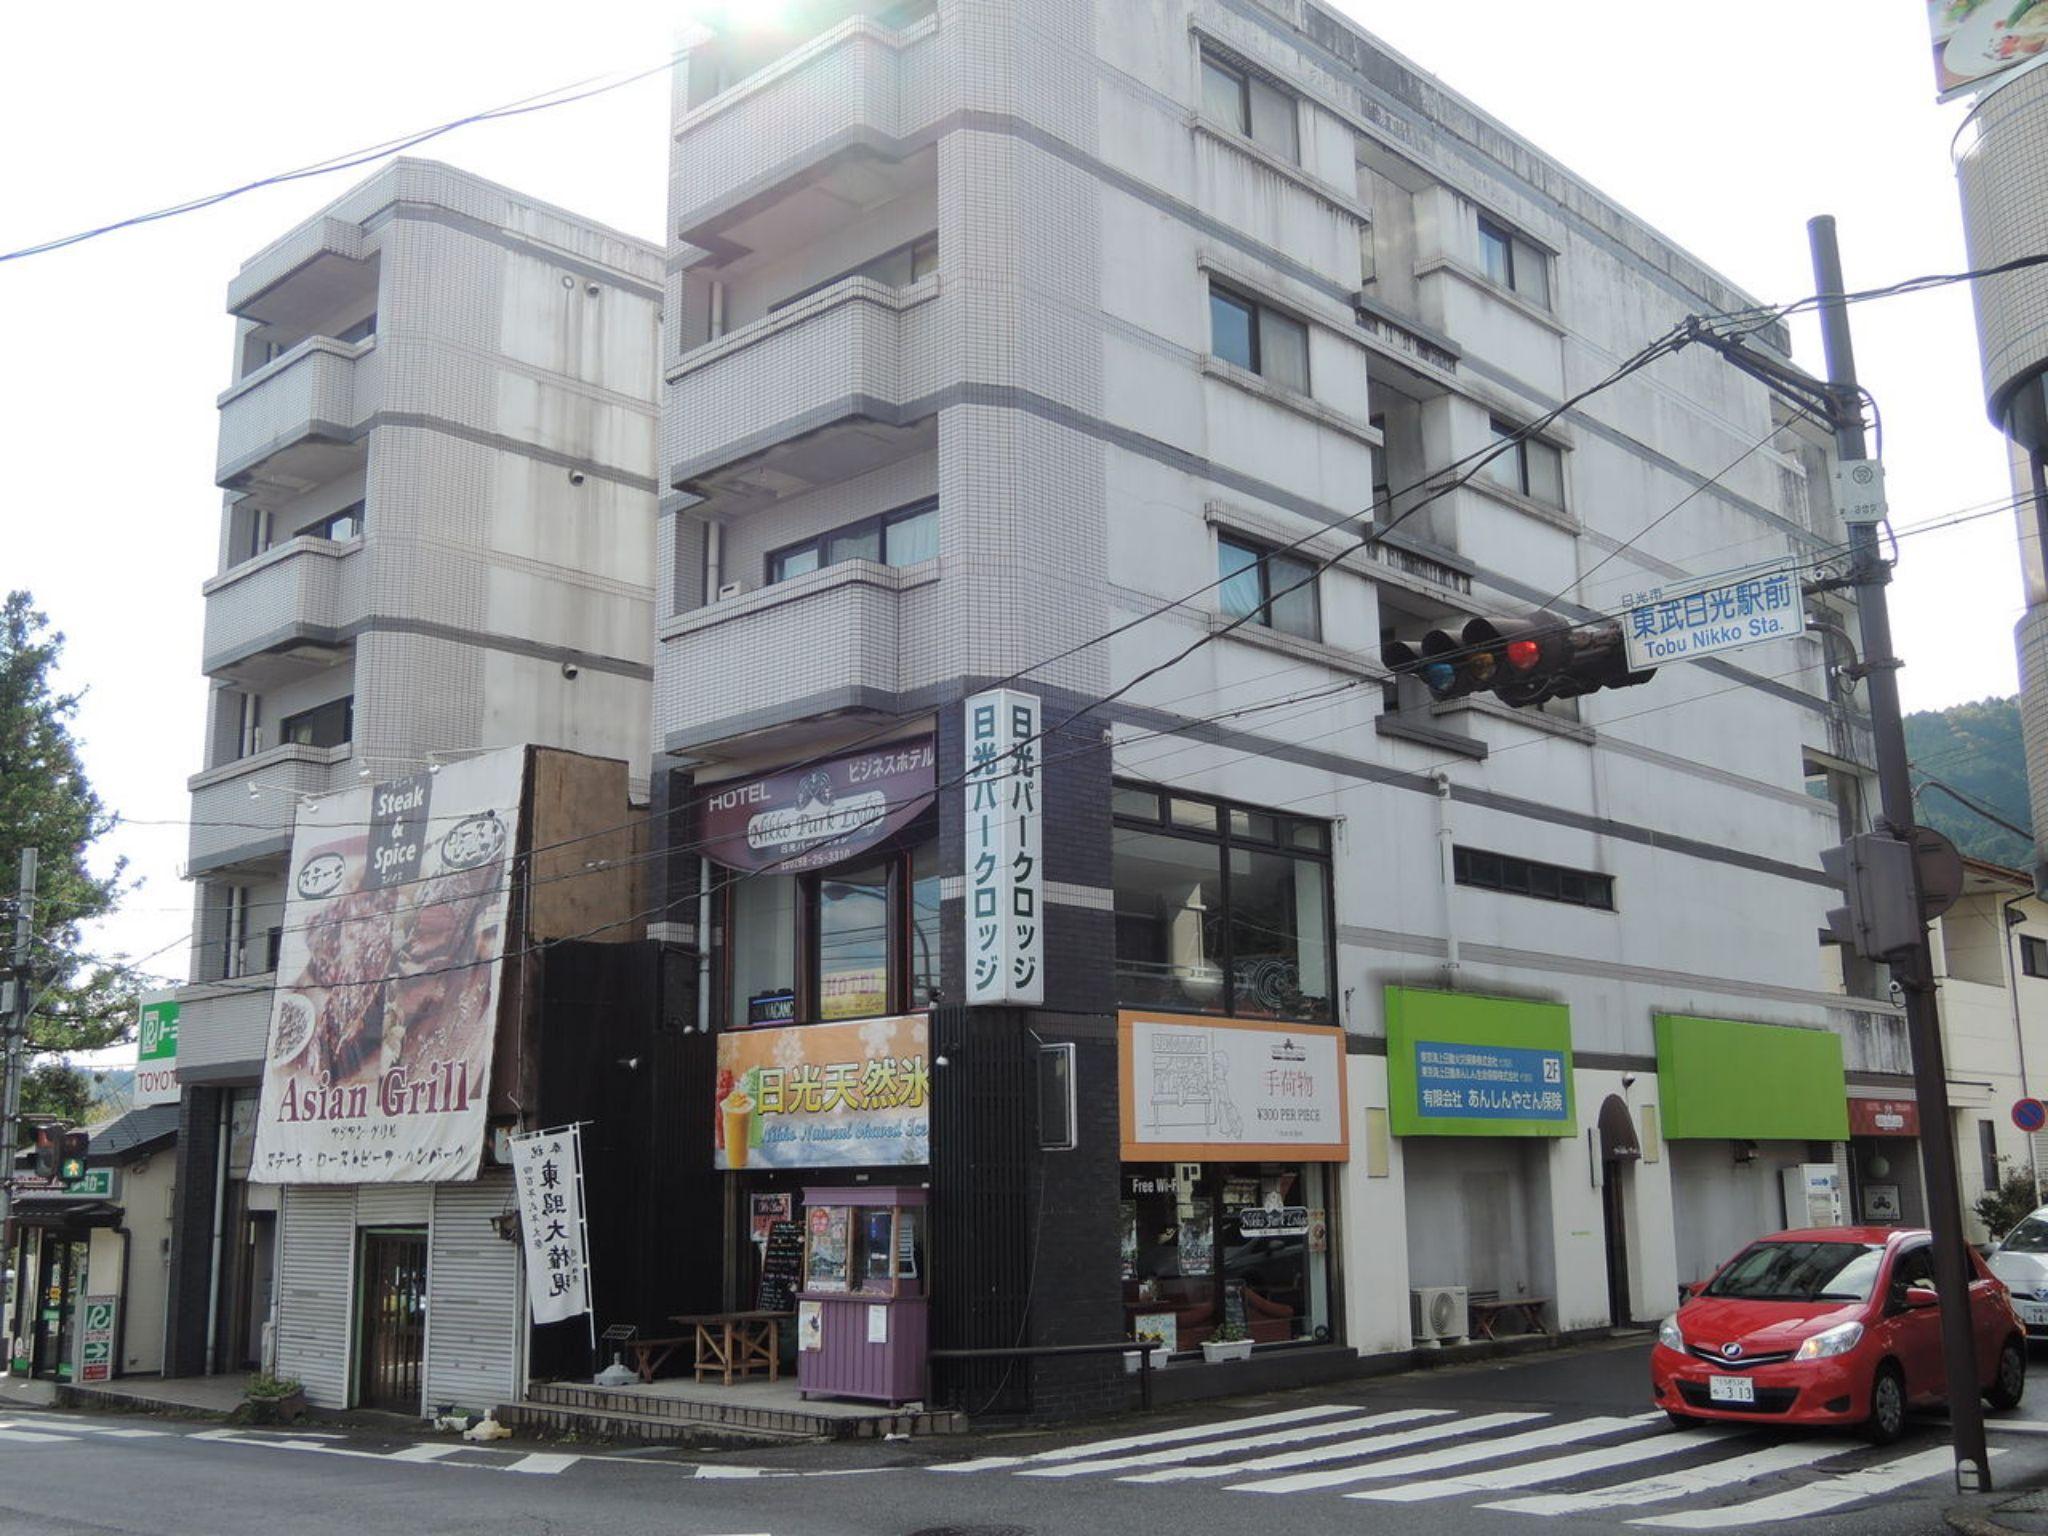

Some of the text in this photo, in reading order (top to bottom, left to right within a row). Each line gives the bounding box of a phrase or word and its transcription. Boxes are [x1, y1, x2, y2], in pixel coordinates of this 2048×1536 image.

[1631, 574, 1791, 641] 東武日光駅前
[1644, 616, 1785, 659] Tobu Nikko Sta.
[848, 746, 935, 783] ビジネスホテル
[377, 785, 425, 817] Steak
[708, 783, 772, 812] HOTEL
[373, 843, 417, 874] Spice
[972, 704, 997, 991] 日光パークロッジ
[1011, 704, 1035, 990] 日光パークロッジ
[758, 1055, 930, 1116] 日光天然氷
[1266, 1069, 1314, 1098] 手荷物
[1545, 1060, 1559, 1081] 2F
[276, 1059, 470, 1123] Asian Grill
[1423, 1089, 1463, 1108] 有限会社
[1256, 1108, 1279, 1121] ¥300
[1280, 1108, 1296, 1121] PER
[1132, 1178, 1154, 1193] Free
